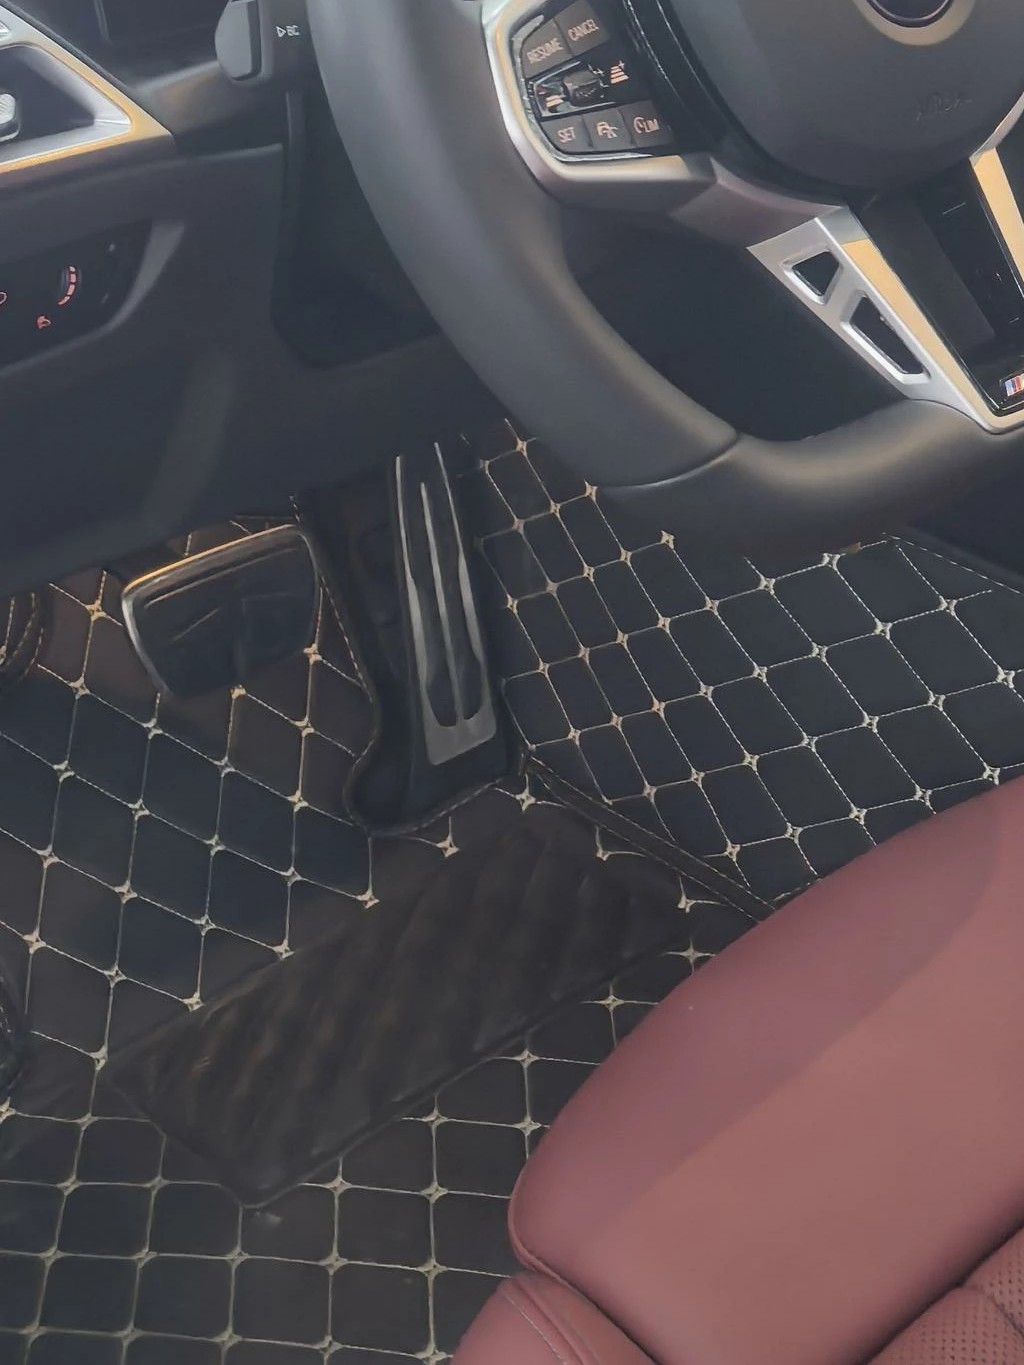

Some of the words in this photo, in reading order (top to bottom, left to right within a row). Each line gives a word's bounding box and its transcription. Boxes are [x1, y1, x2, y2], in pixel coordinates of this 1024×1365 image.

[567, 18, 600, 42] CANCEL
[526, 37, 565, 64] RESUME
[556, 125, 577, 144] SET
